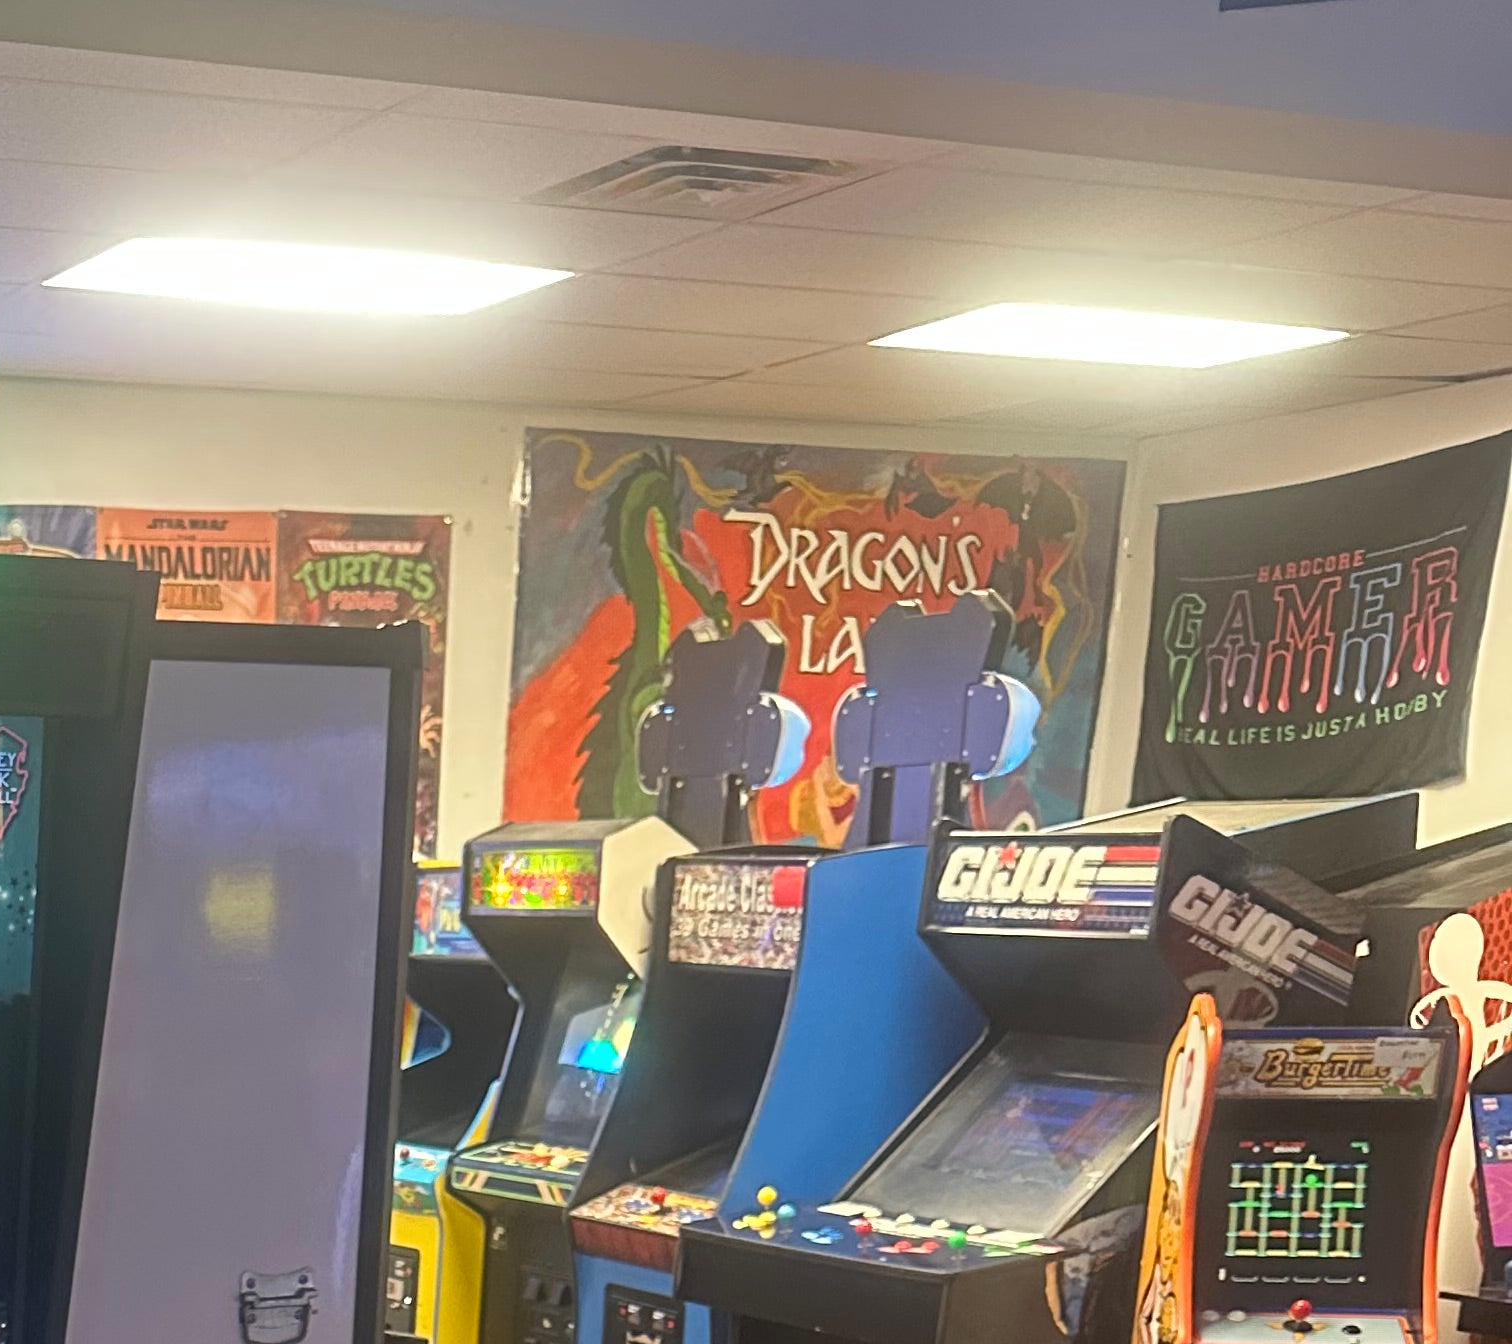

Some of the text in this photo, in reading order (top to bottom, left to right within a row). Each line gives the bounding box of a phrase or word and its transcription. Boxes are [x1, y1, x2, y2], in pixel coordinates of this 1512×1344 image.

[104, 543, 272, 582] MANDALORIAN
[723, 508, 982, 606] DRAGON'S
[1257, 550, 1366, 583] HARDCORE
[293, 553, 436, 601] TURTLES
[799, 614, 876, 674] LA
[1164, 546, 1458, 715] GAMER
[1227, 727, 1271, 746] LIFE
[1276, 724, 1296, 742] IS
[678, 873, 737, 912] Arcade
[698, 917, 750, 939] Games
[1256, 1049, 1391, 1089] BurgerTime
